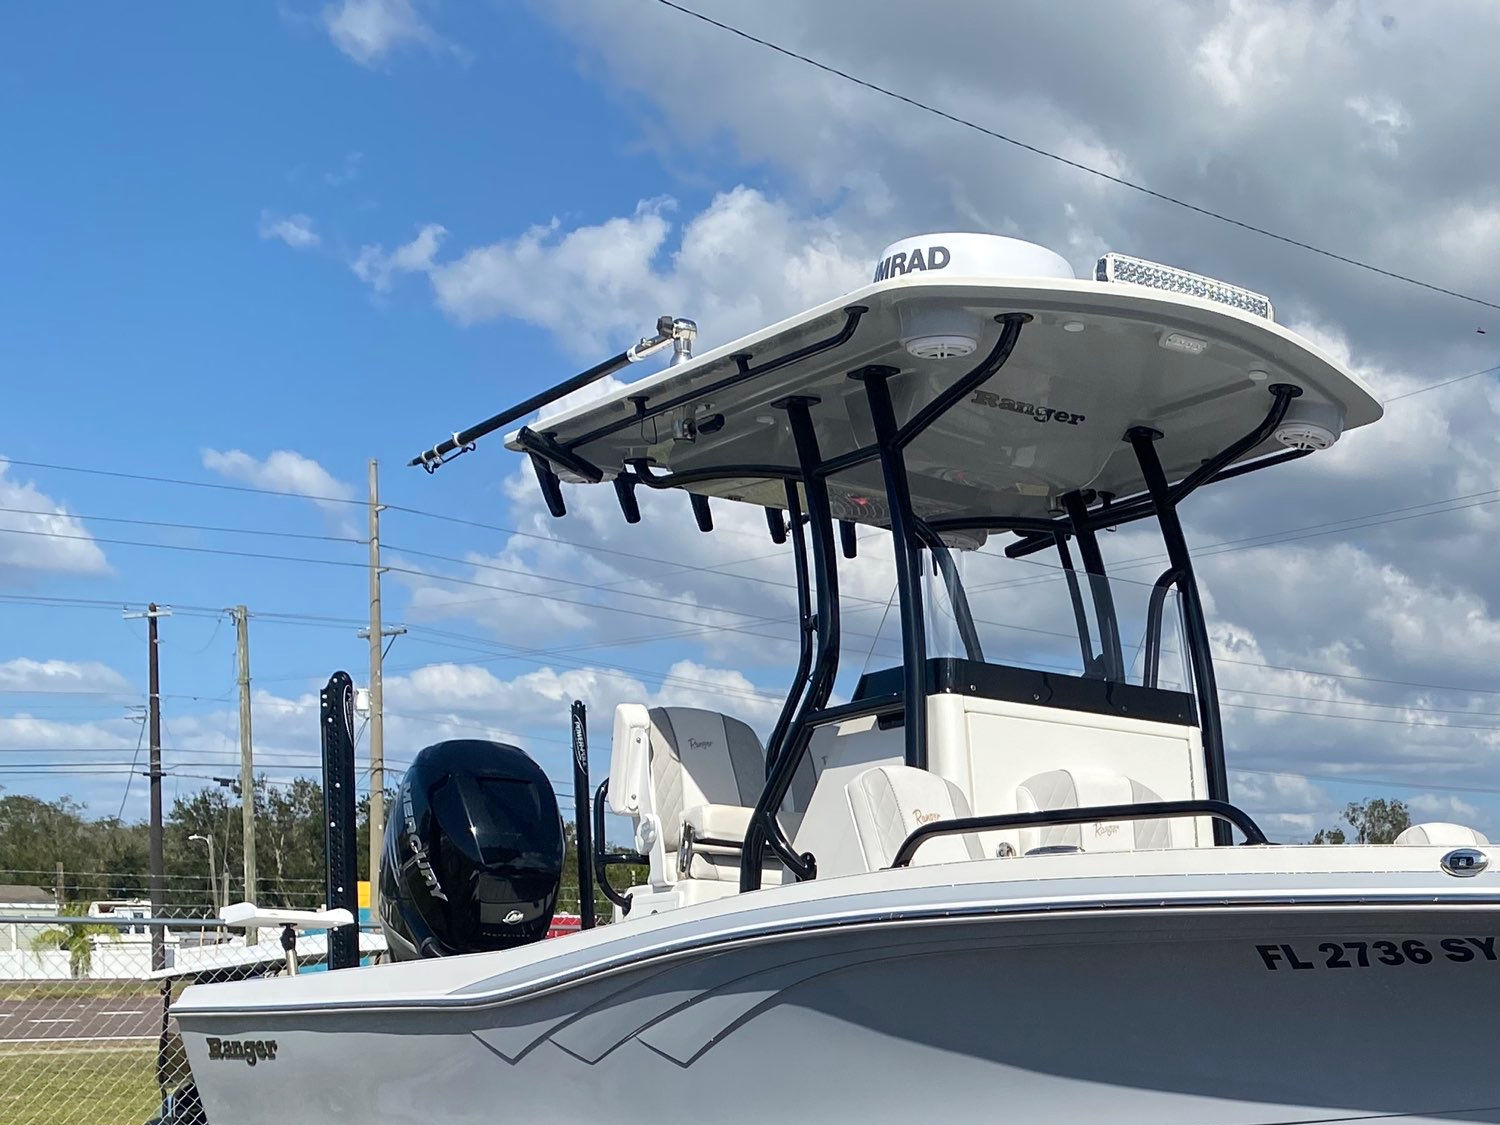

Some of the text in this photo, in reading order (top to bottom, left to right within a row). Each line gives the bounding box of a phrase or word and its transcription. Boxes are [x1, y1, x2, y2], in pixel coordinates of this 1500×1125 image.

[971, 389, 1086, 426] Ranger
[403, 781, 449, 902] MERCURY
[1255, 937, 1498, 971] FL 2736 SY
[206, 1037, 278, 1067] Ranger
